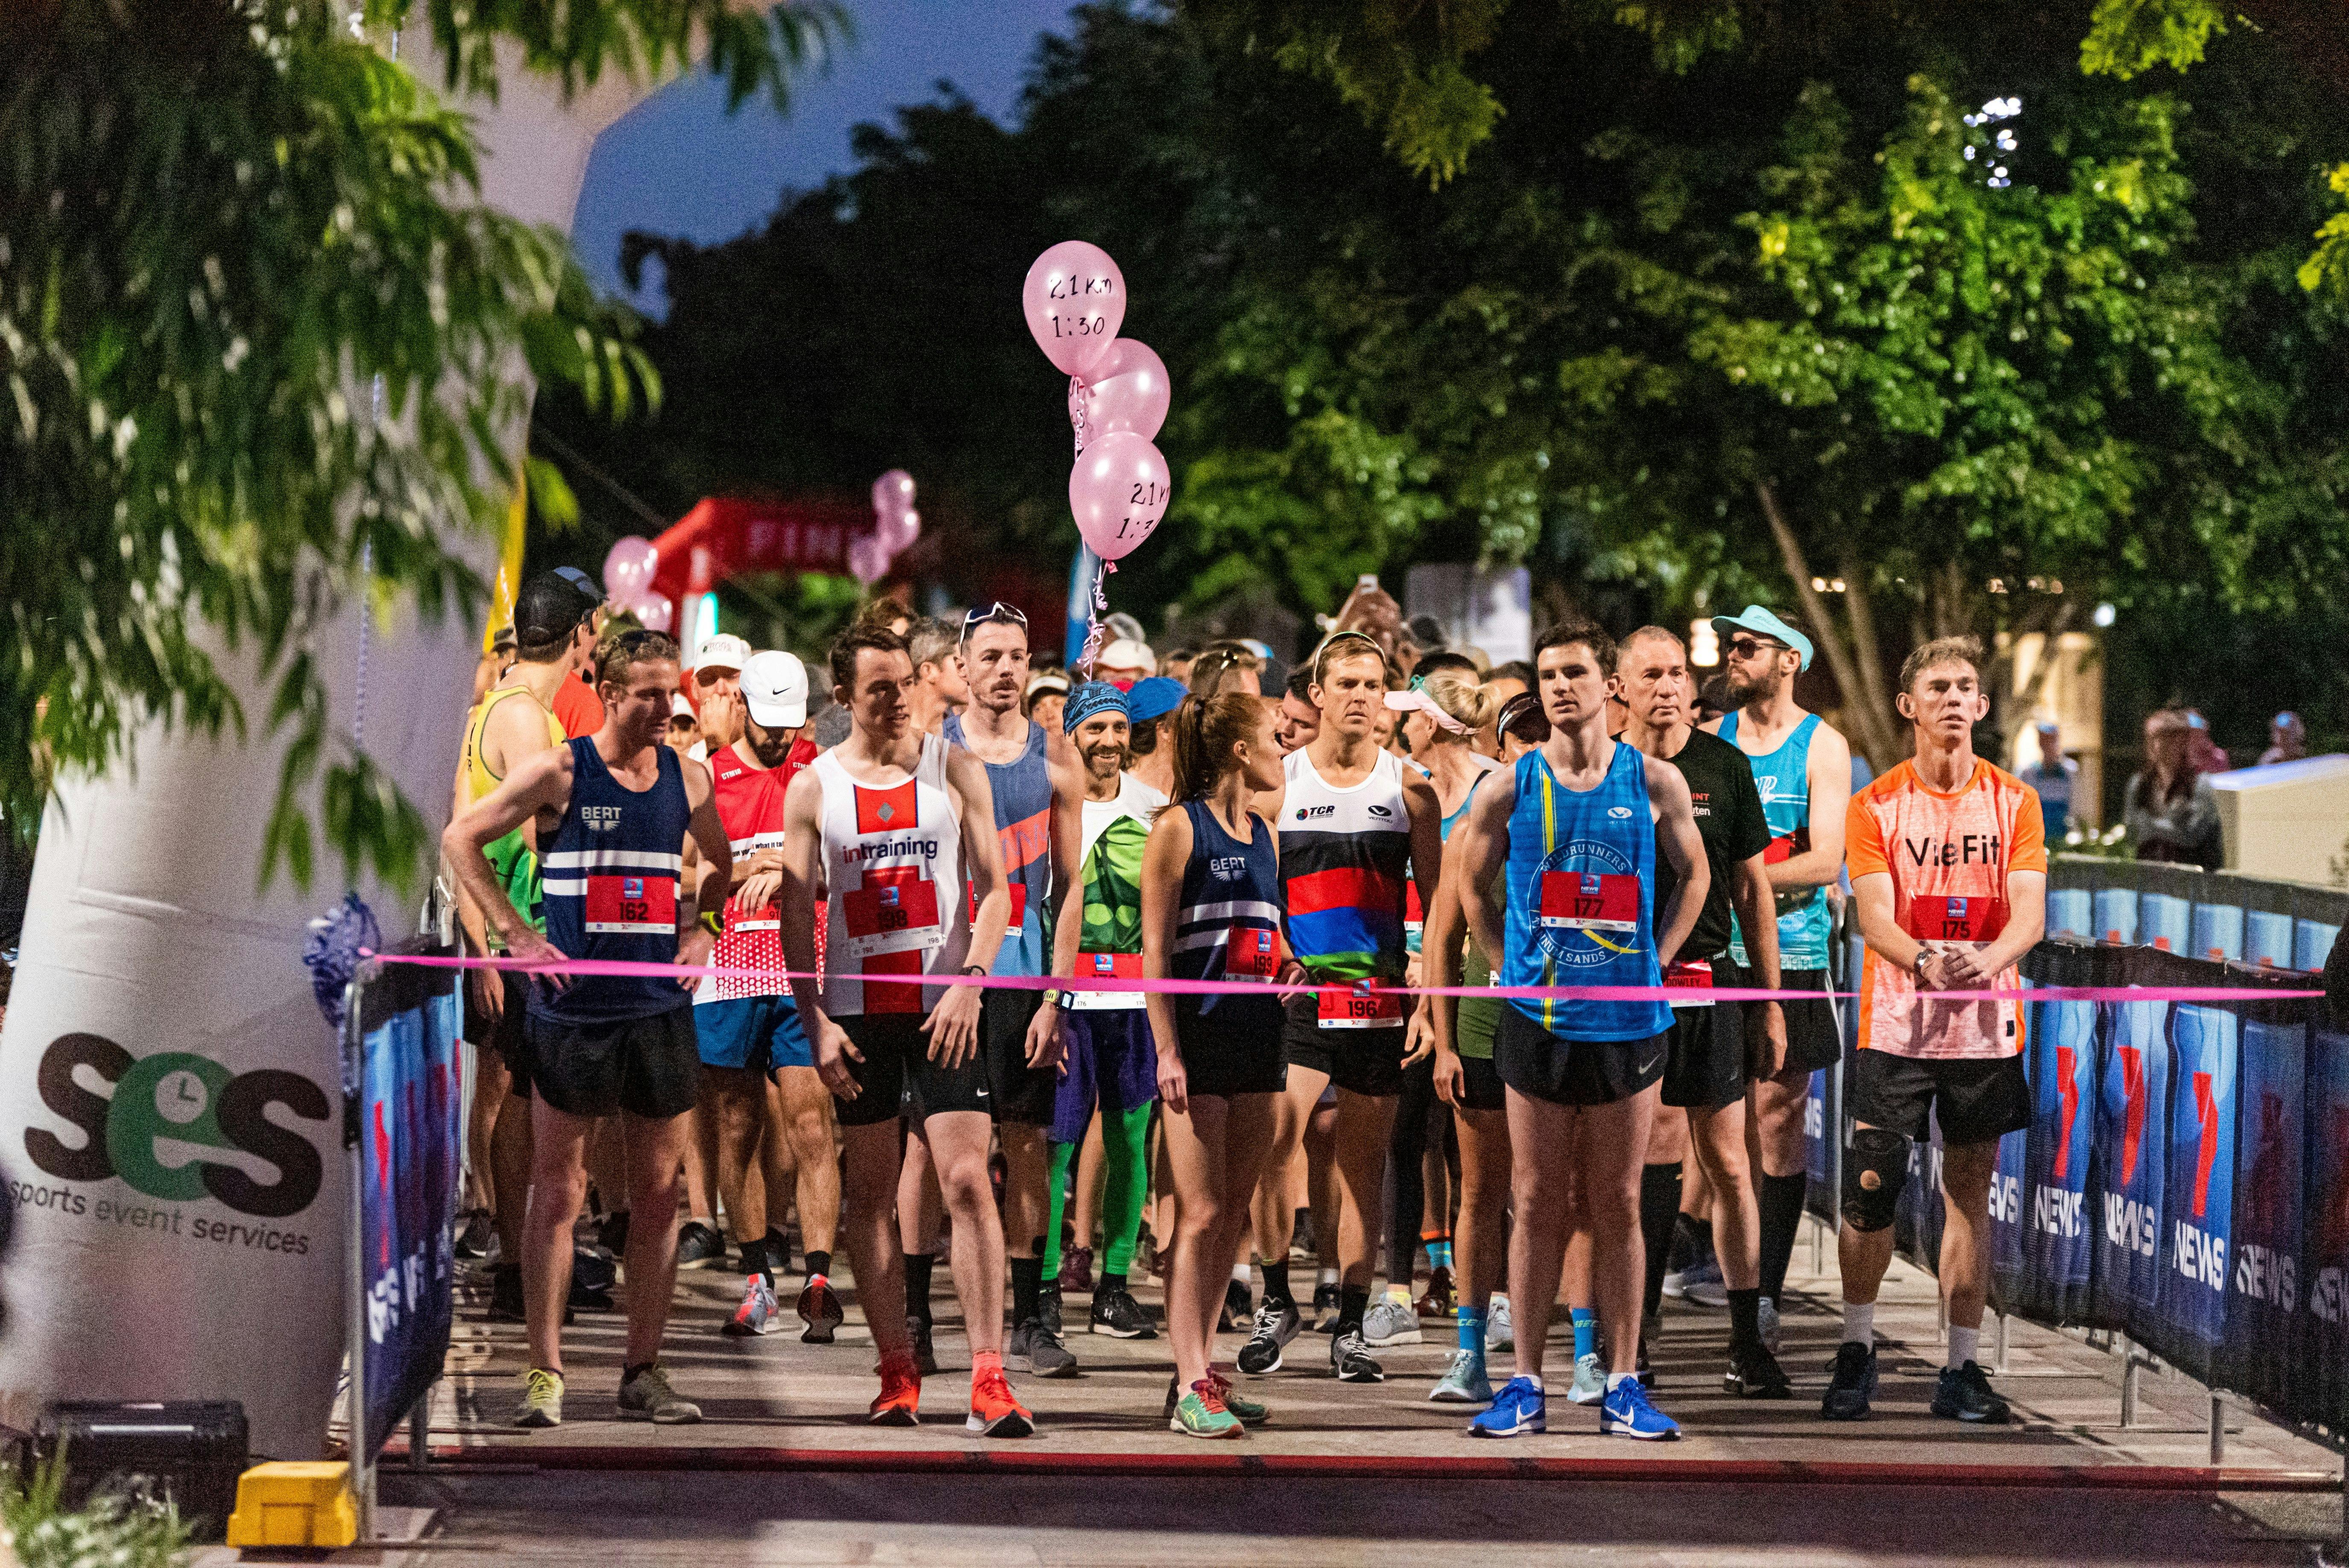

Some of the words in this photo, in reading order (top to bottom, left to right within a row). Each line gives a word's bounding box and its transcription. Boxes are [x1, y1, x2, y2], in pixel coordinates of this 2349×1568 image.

[1052, 316, 1104, 337] 1:30
[582, 806, 622, 819] BERT
[1309, 805, 1335, 816] TCR
[843, 836, 937, 864] intraining
[1905, 835, 2000, 866] VieFit
[1210, 857, 1245, 872] BERT
[619, 901, 649, 921] 162
[1575, 898, 1605, 917] 177
[1942, 921, 1971, 939] 175
[928, 937, 940, 945] 198
[1566, 950, 1606, 964] SANDS
[1347, 1000, 1378, 1018] 196
[9, 1179, 87, 1215] sports
[95, 1200, 184, 1235] event
[193, 1217, 310, 1255] services
[2173, 1219, 2225, 1291] NEWS
[2236, 1243, 2295, 1313] NEWS
